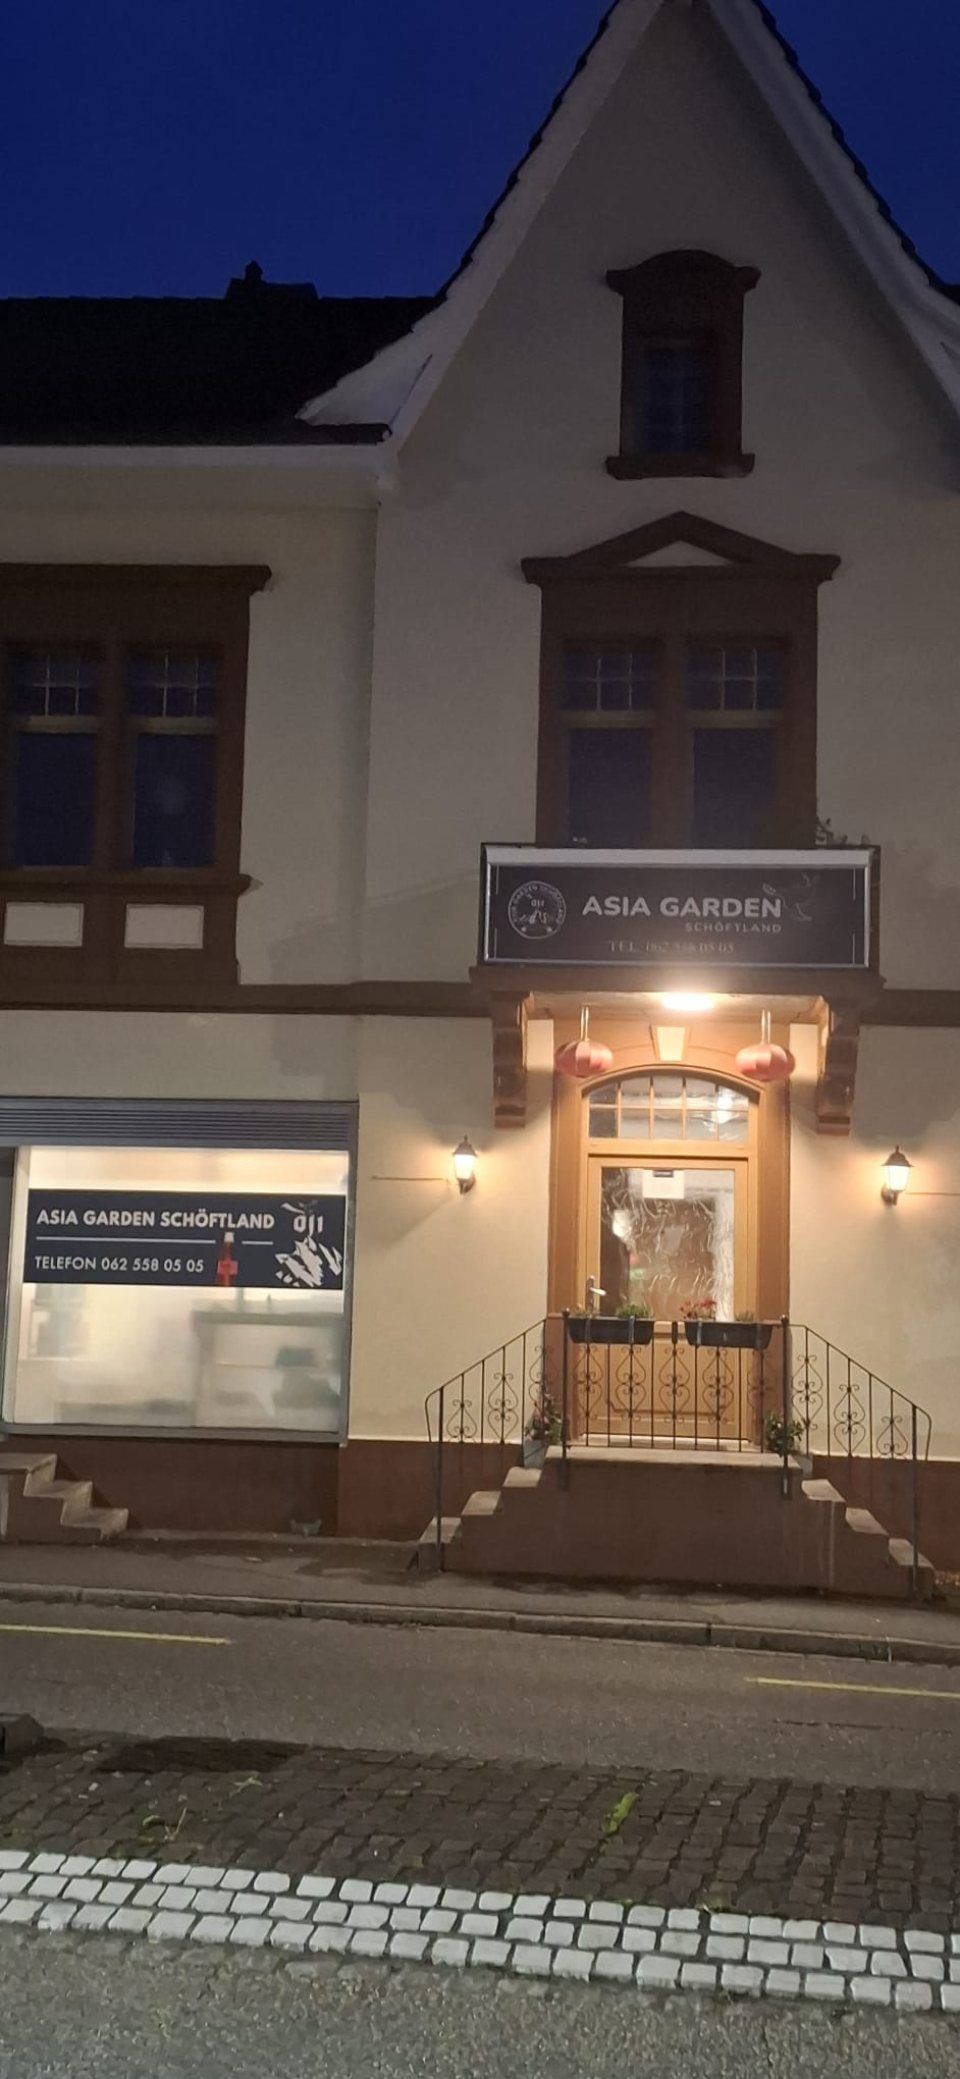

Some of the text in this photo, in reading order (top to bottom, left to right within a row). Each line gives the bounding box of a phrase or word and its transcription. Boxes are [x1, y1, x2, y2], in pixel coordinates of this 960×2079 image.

[582, 896, 651, 916] ASIA
[660, 897, 781, 918] GARDEN
[685, 921, 782, 933] SCHÖFTLAND
[36, 1208, 275, 1229] ASIA GARDEN SCHÖFTLAND
[35, 1256, 204, 1273] TELEFON 062 558 05 05
